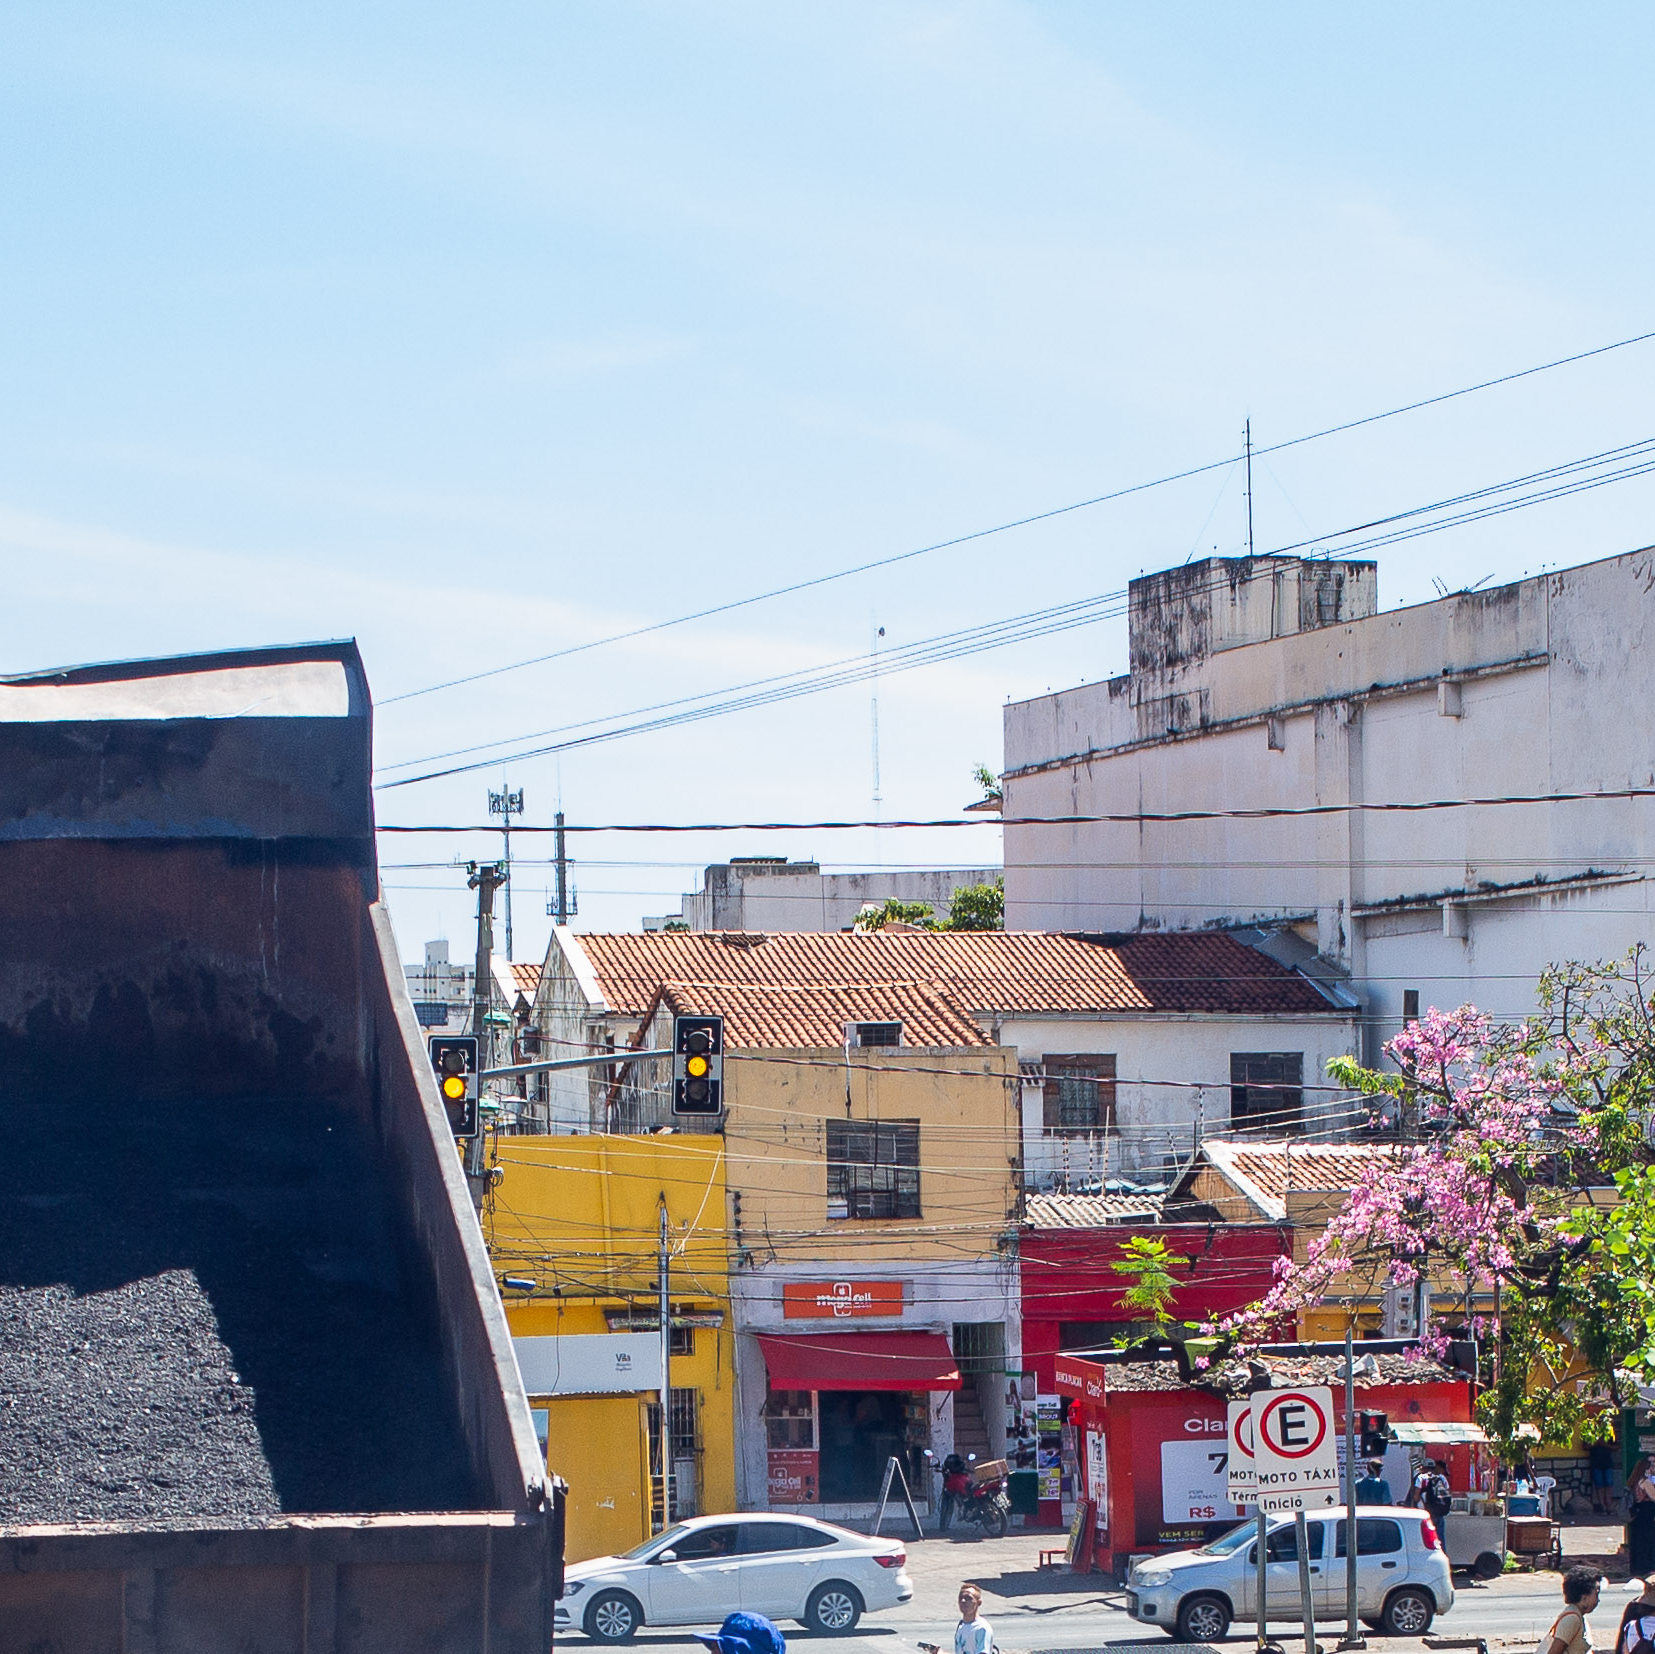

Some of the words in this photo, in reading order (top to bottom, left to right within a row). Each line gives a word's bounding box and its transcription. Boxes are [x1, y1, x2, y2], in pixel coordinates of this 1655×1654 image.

[1184, 1418, 1228, 1432] Cla
[1278, 1405, 1309, 1447] E
[1229, 1471, 1257, 1480] MOT
[1258, 1471, 1297, 1484] MOTO
[1303, 1467, 1336, 1481] TÁXI
[1231, 1491, 1258, 1501] Térm
[1263, 1497, 1303, 1510] Início
[1189, 1505, 1217, 1518] R$
